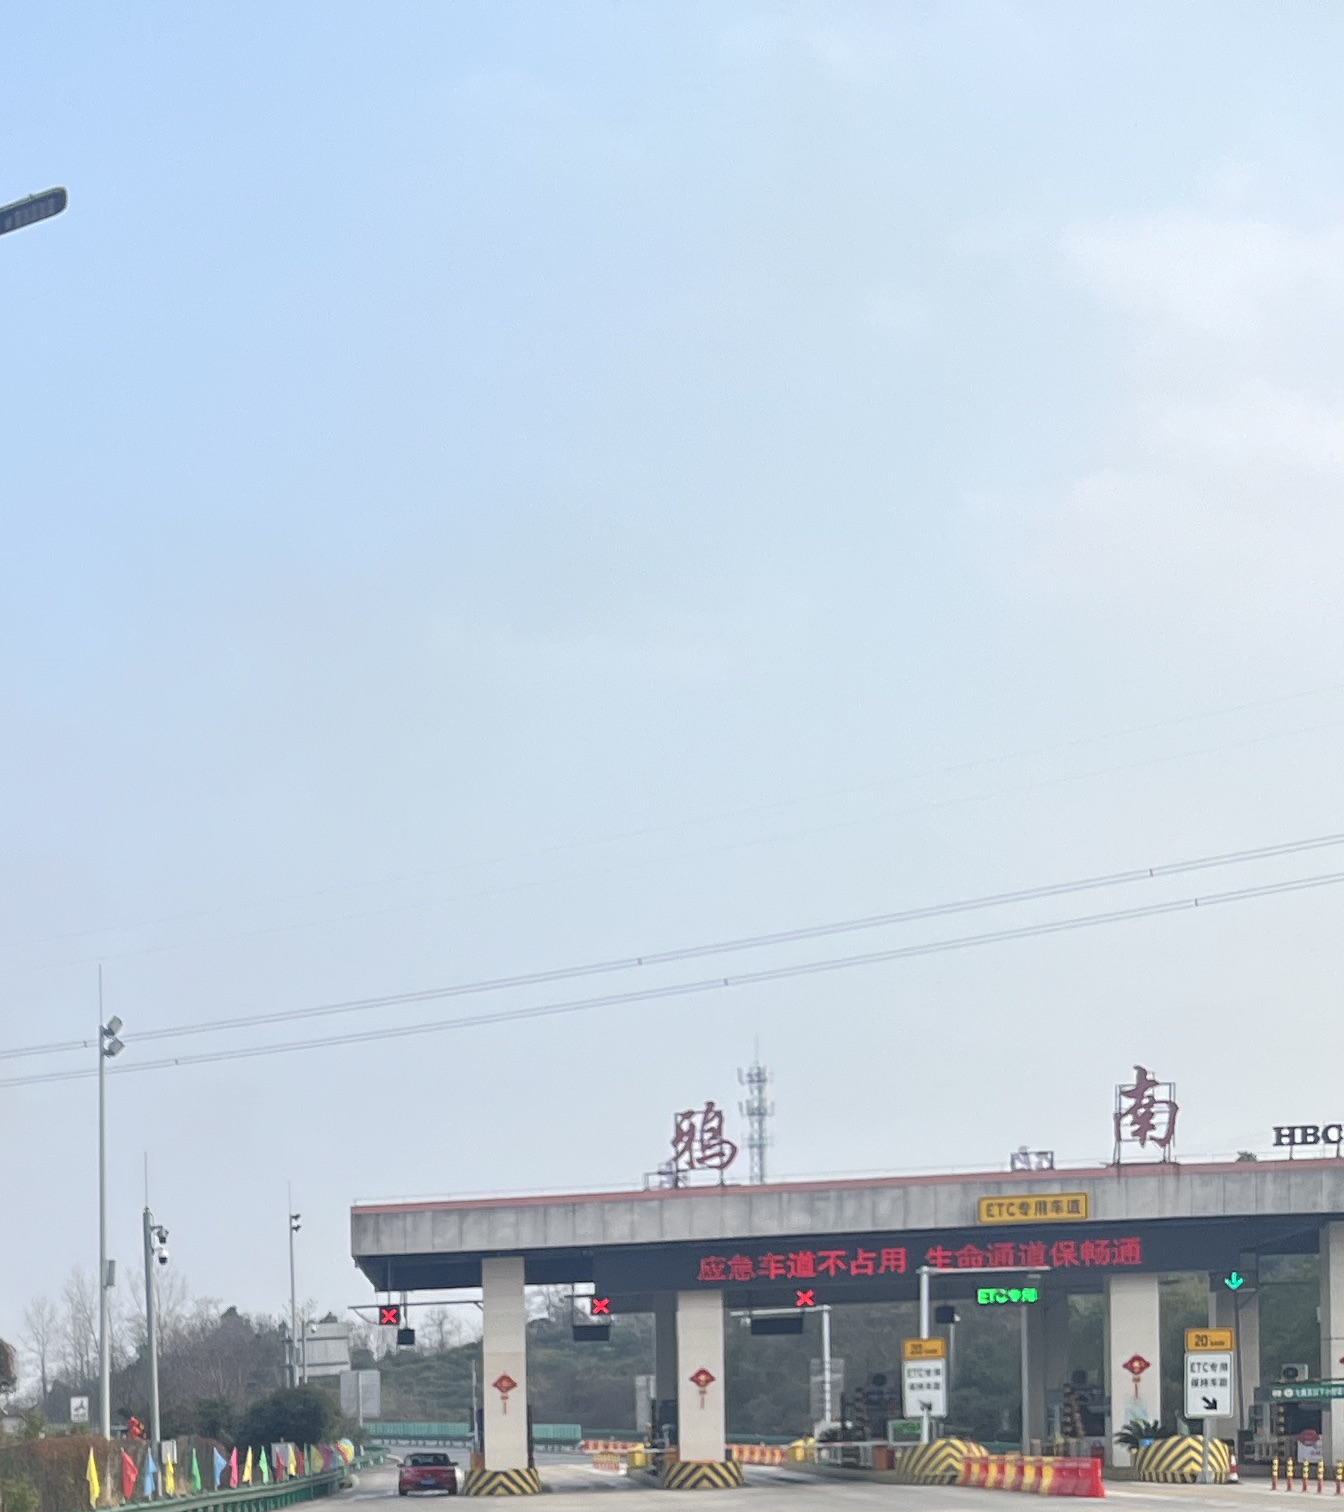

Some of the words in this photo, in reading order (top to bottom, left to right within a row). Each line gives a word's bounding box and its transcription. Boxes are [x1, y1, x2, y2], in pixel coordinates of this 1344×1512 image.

[672, 1101, 737, 1170] 鸦
[1114, 1065, 1179, 1148] 南
[985, 1199, 1081, 1218] ETC专用车道
[698, 1247, 908, 1281] 应急车道不占用
[926, 1237, 1142, 1270] 生命通道保畅通
[977, 1287, 1038, 1304] ETC专用
